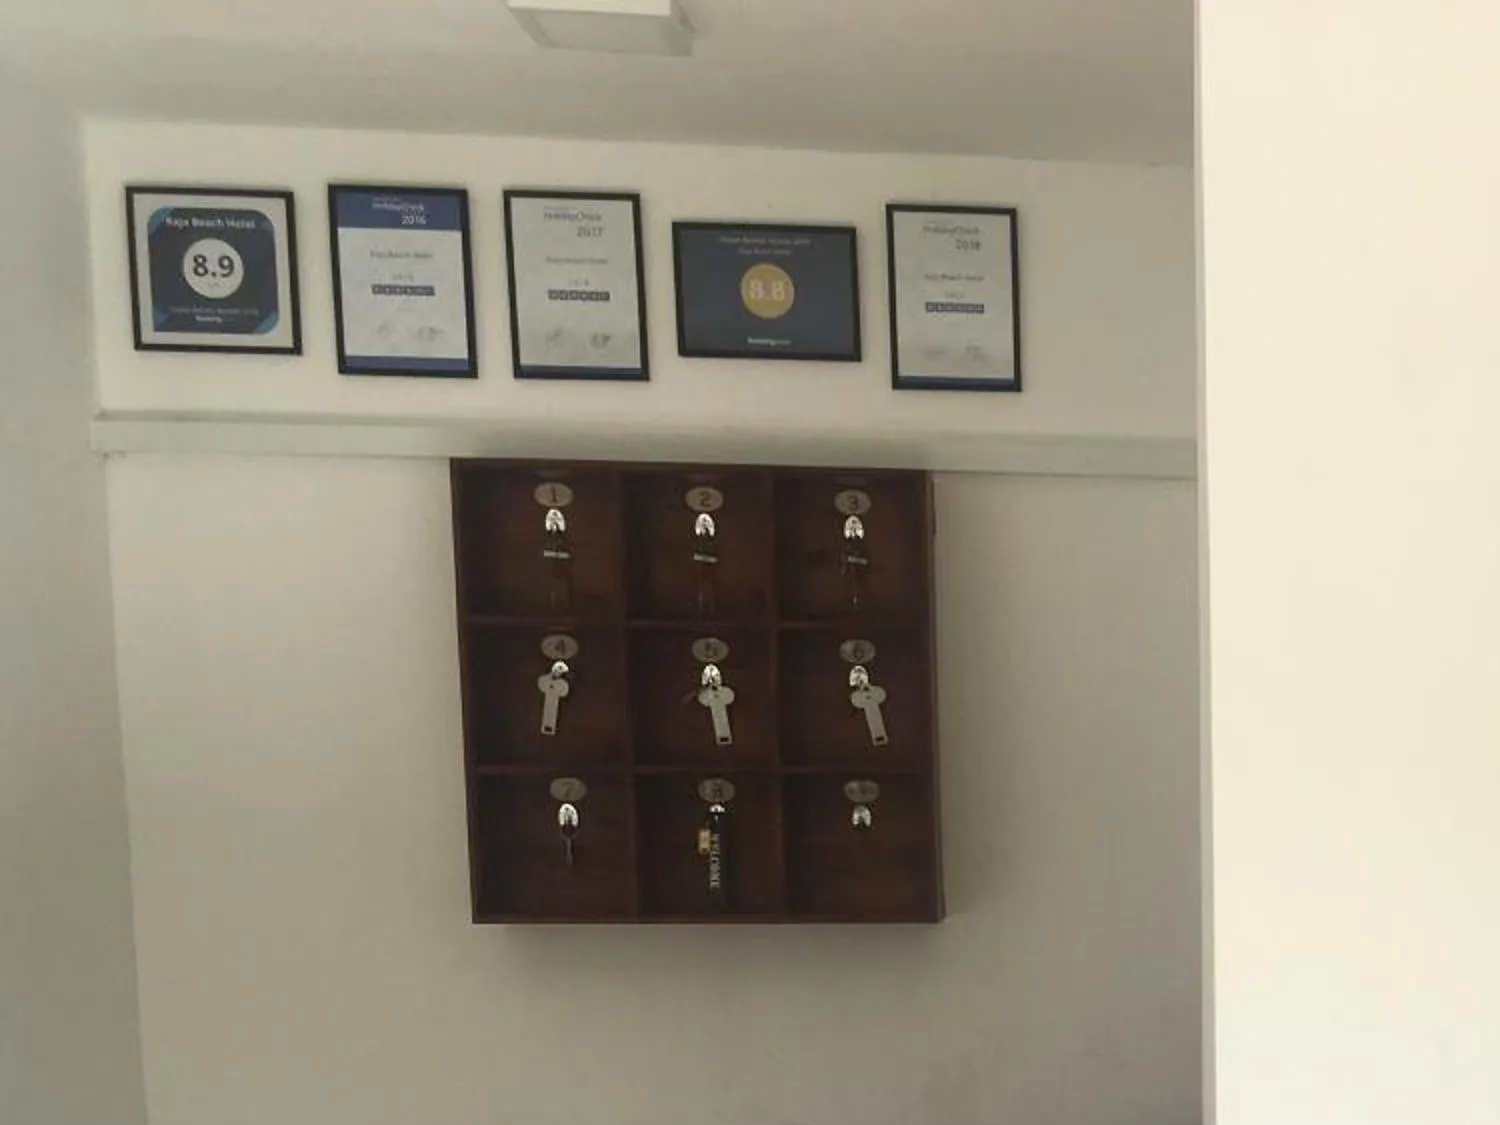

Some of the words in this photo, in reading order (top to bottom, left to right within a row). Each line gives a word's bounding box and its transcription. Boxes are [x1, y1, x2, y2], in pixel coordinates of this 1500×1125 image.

[191, 217, 224, 229] Beach
[192, 254, 235, 278] 8.9
[749, 279, 786, 302] 8.8
